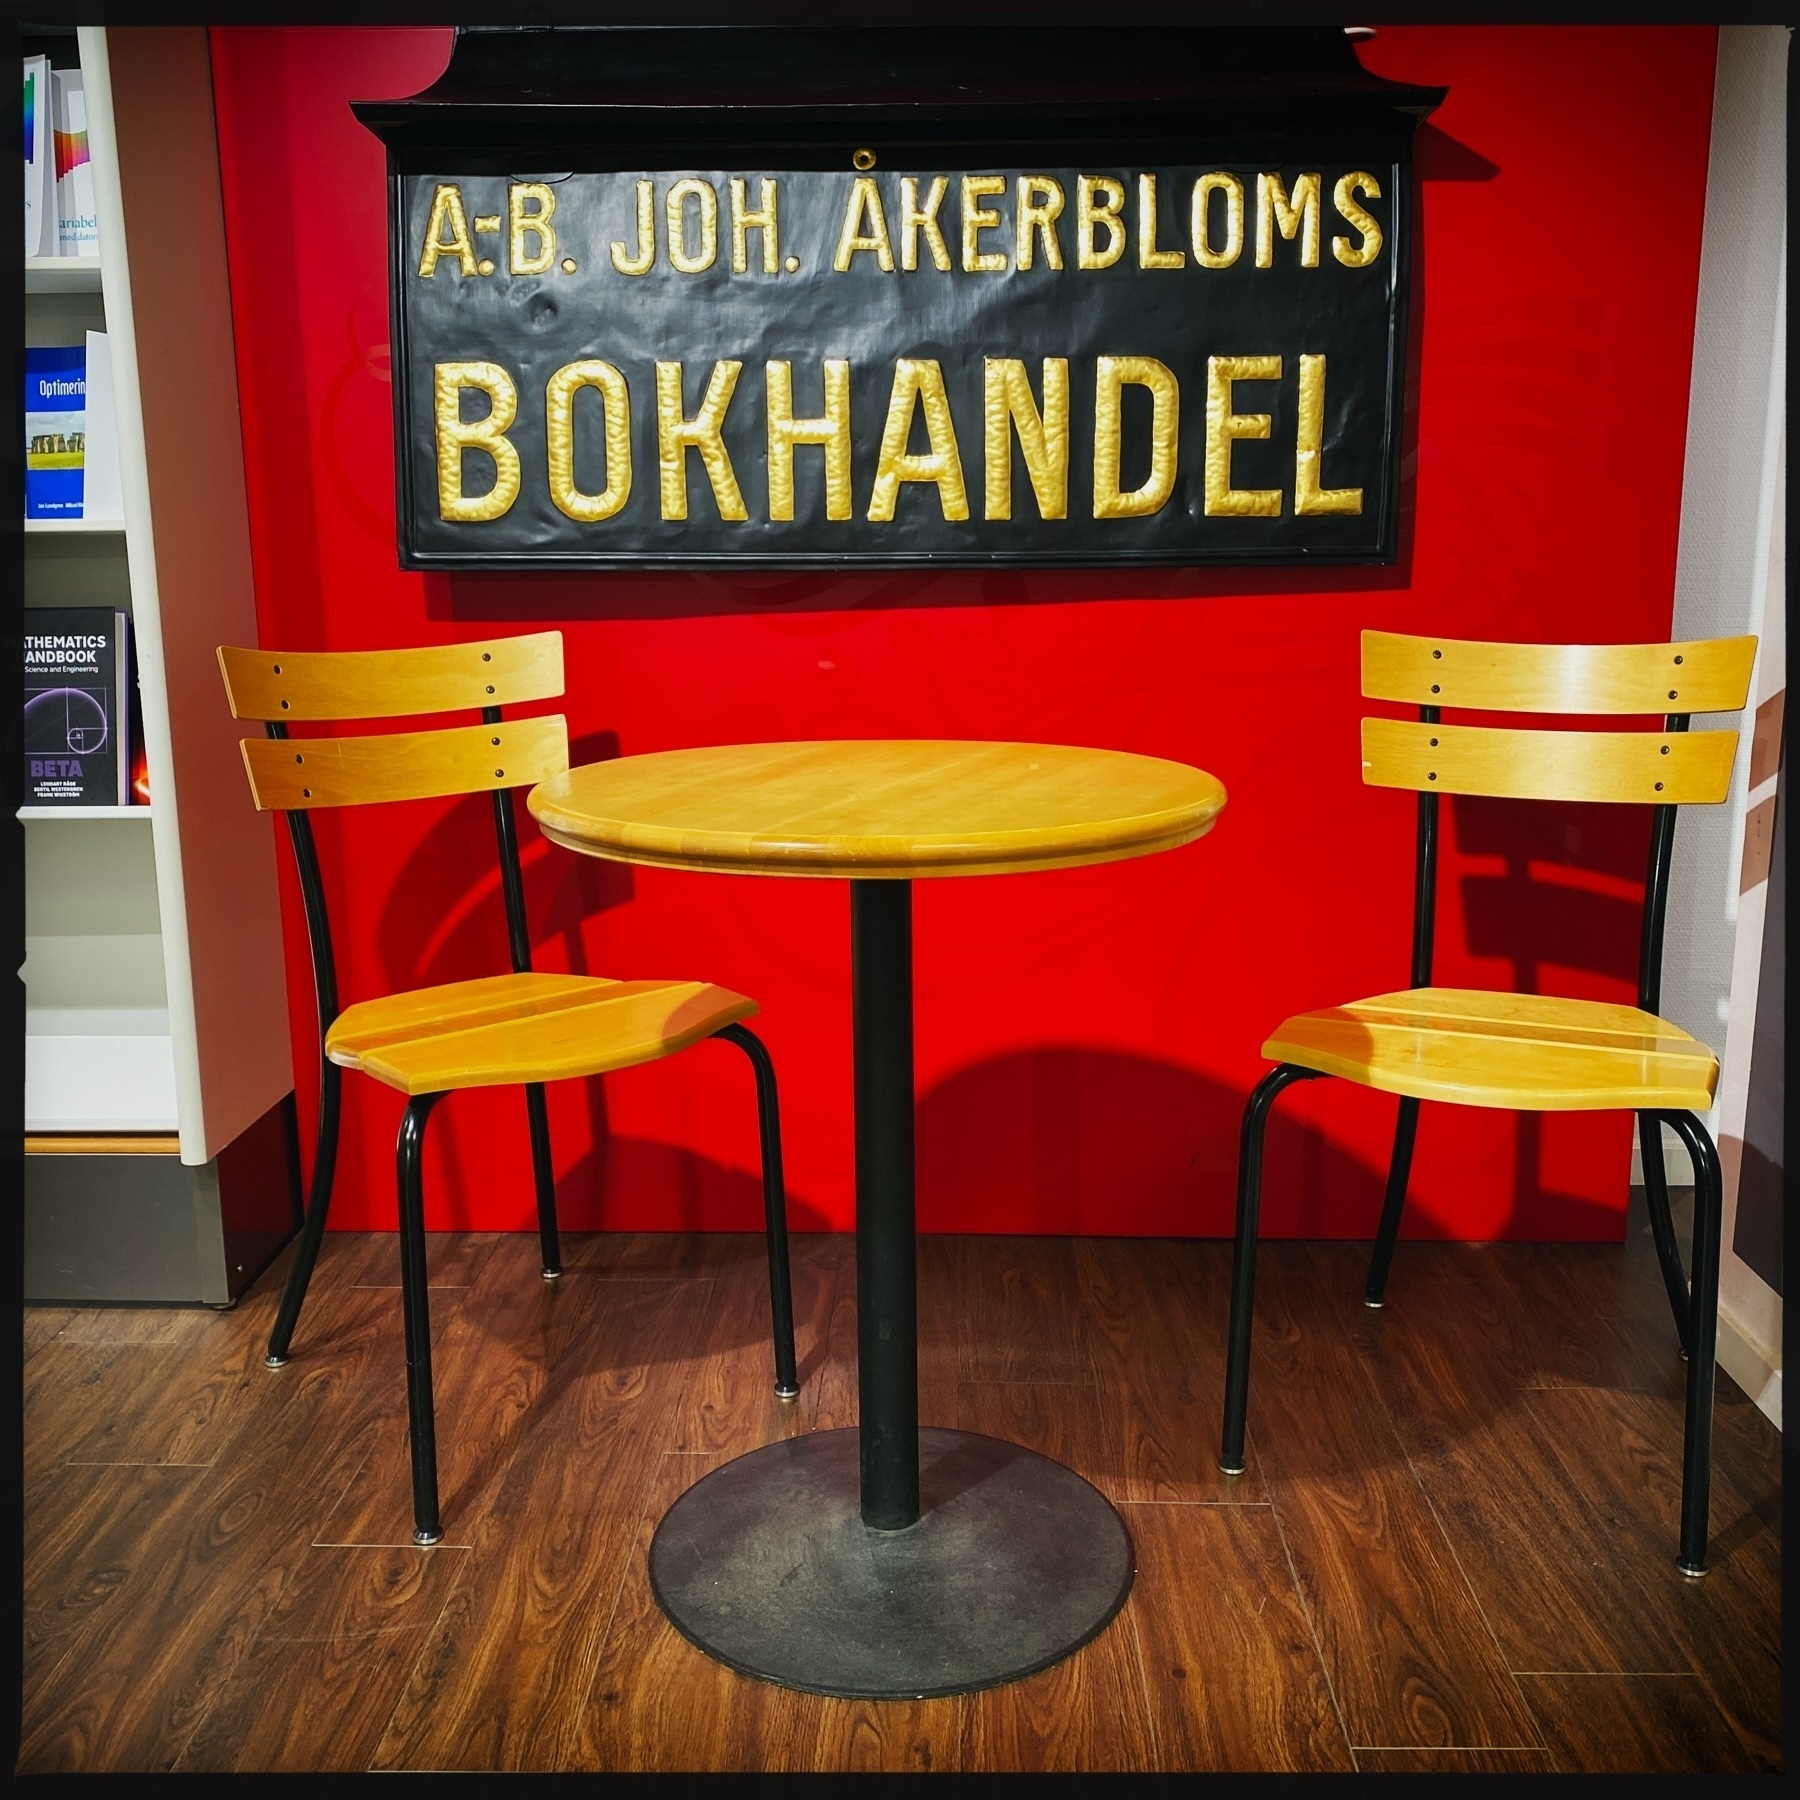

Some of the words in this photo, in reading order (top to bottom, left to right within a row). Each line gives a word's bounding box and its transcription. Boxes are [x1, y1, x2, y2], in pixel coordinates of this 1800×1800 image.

[610, 177, 802, 276] JOH.
[833, 148, 1383, 273] ÅKERBLOMS
[433, 353, 1364, 524] BOKHANDEL
[24, 635, 107, 648] THEMATICS
[24, 650, 97, 663] ANDBOOK
[63, 665, 98, 673] Engineering
[31, 760, 83, 777] BETA
